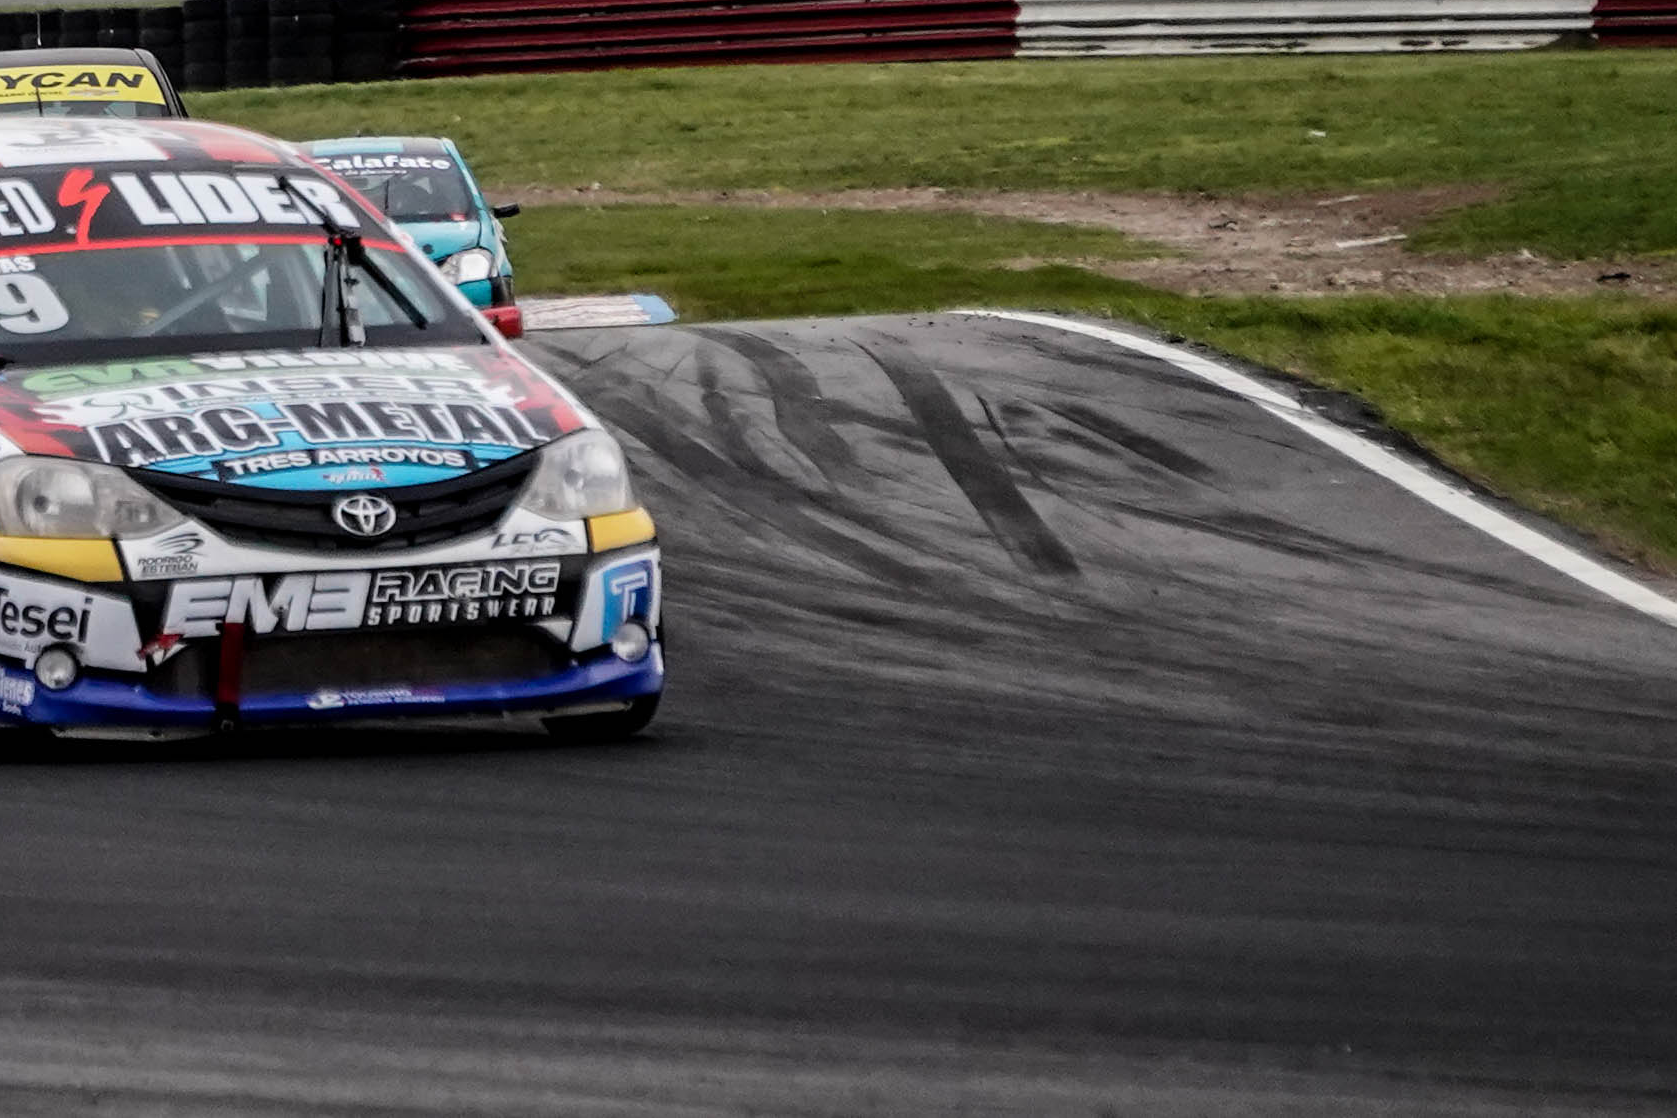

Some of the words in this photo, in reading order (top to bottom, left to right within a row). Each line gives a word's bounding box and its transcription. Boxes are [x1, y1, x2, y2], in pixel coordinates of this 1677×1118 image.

[110, 171, 361, 228] LIDER
[161, 375, 483, 401] INSER
[86, 400, 551, 469] ARG-METAL
[225, 452, 312, 477] TRES
[318, 445, 466, 468] ARROYOS
[374, 563, 561, 604] RACING
[368, 596, 557, 628] SPORTSWEAR
